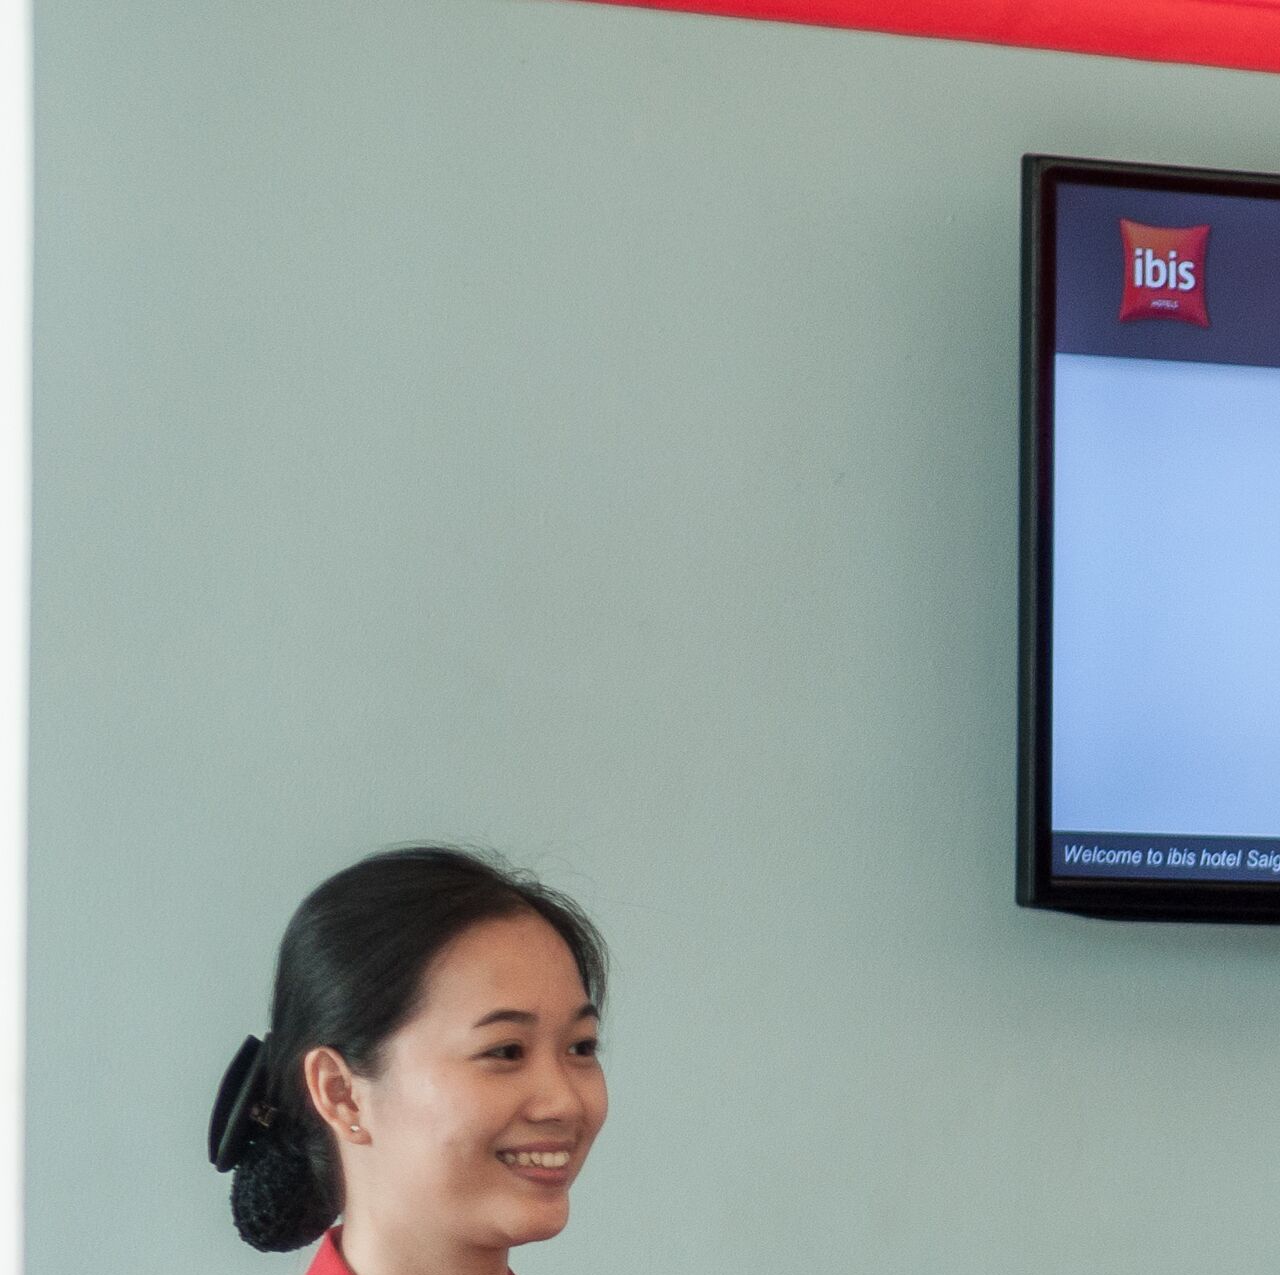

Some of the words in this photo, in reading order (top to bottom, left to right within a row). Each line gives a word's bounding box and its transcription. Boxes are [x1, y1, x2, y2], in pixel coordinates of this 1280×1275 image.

[1134, 247, 1195, 291] ibis
[1063, 844, 1142, 865] Welcome
[1146, 847, 1162, 866] to
[1167, 847, 1195, 867] ibis
[1200, 849, 1242, 868] hotel
